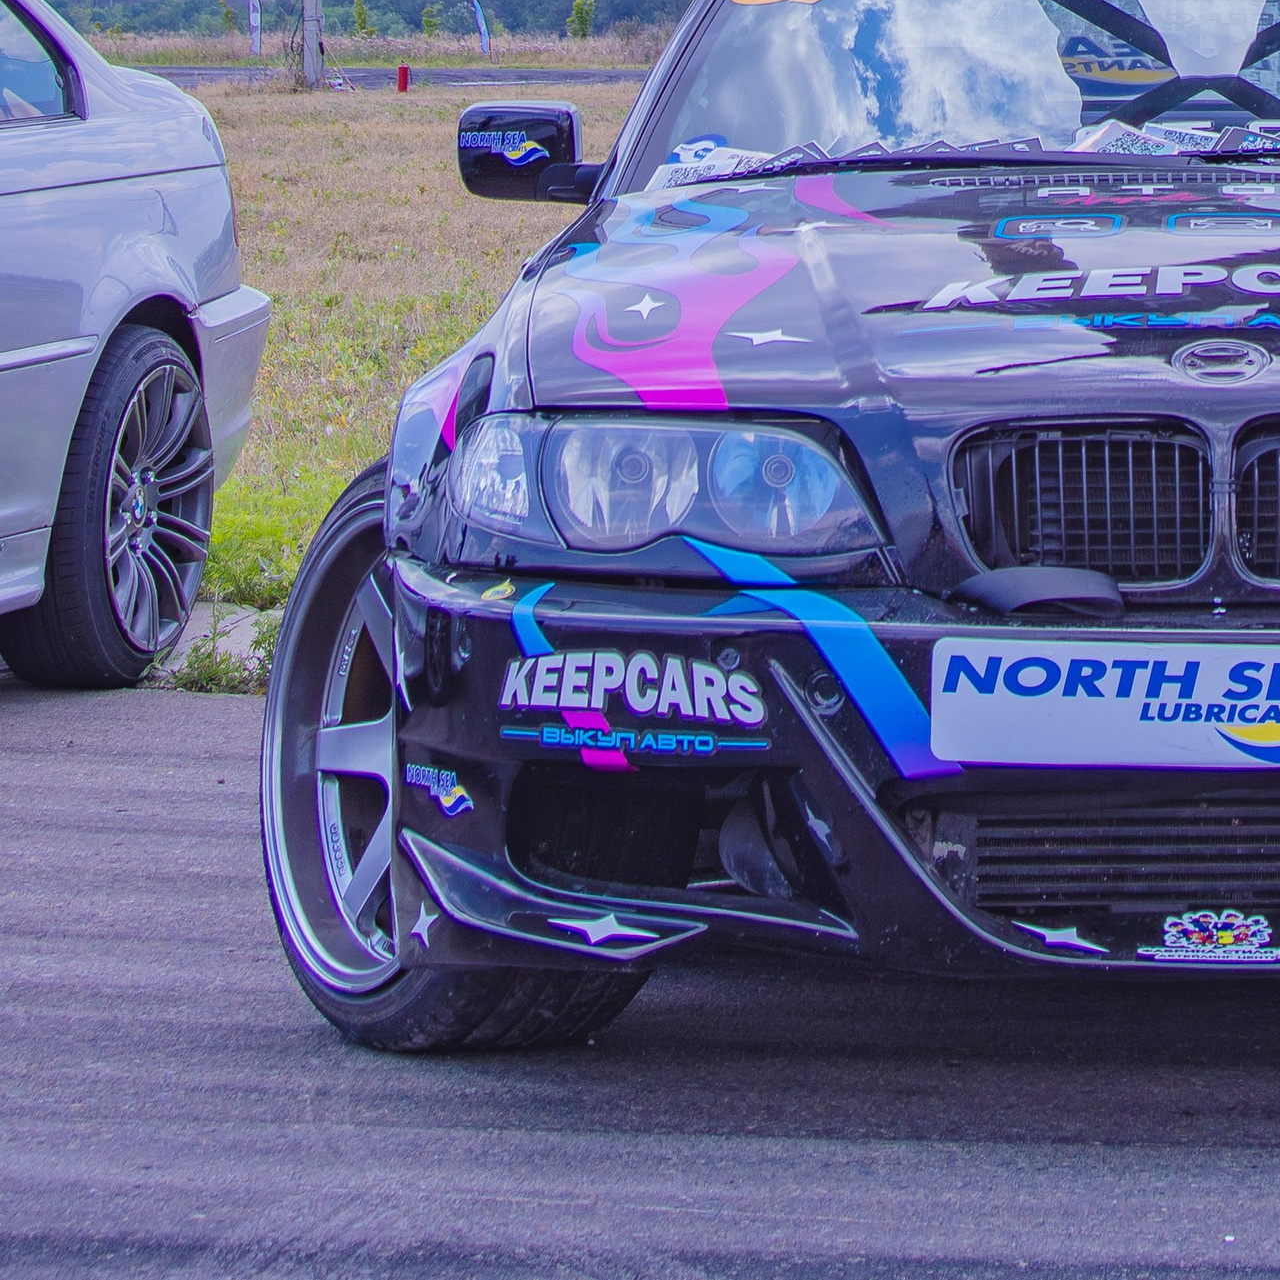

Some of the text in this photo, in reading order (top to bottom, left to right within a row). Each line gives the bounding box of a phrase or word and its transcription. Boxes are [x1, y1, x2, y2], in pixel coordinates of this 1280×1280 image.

[459, 130, 527, 148] NORTH SEA
[1013, 313, 1243, 330] ВЫКУП
[499, 651, 766, 728] KEEPCARS
[942, 654, 1201, 700] NORTH
[541, 727, 715, 752] ВЫКУП АВТО
[406, 763, 457, 788] NORTH SEA
